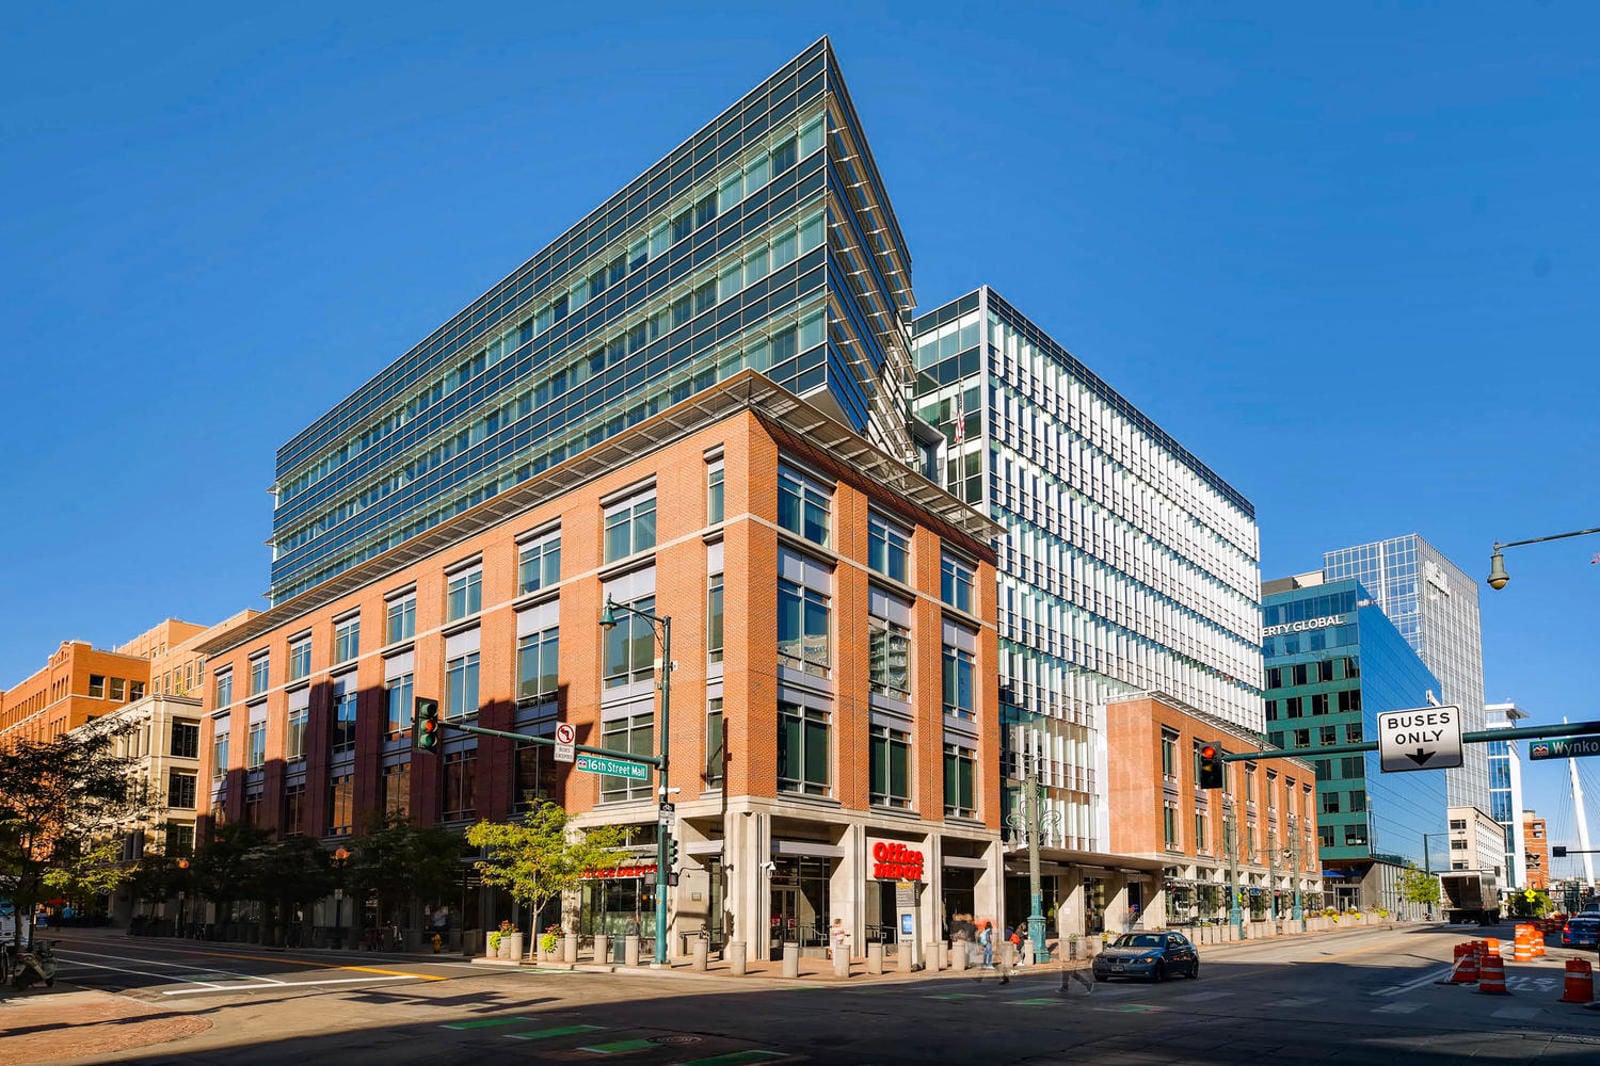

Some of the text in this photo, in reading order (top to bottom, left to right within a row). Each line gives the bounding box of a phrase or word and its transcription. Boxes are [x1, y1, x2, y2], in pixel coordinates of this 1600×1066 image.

[1262, 615, 1344, 637] ERTY GLOBAL
[1387, 712, 1451, 730] BUSES
[1395, 729, 1444, 745] ONLY
[1552, 740, 1600, 756] Wynko
[587, 759, 645, 777] 16th Street Mall
[873, 841, 924, 865] Office
[873, 863, 923, 881] DEPOT
